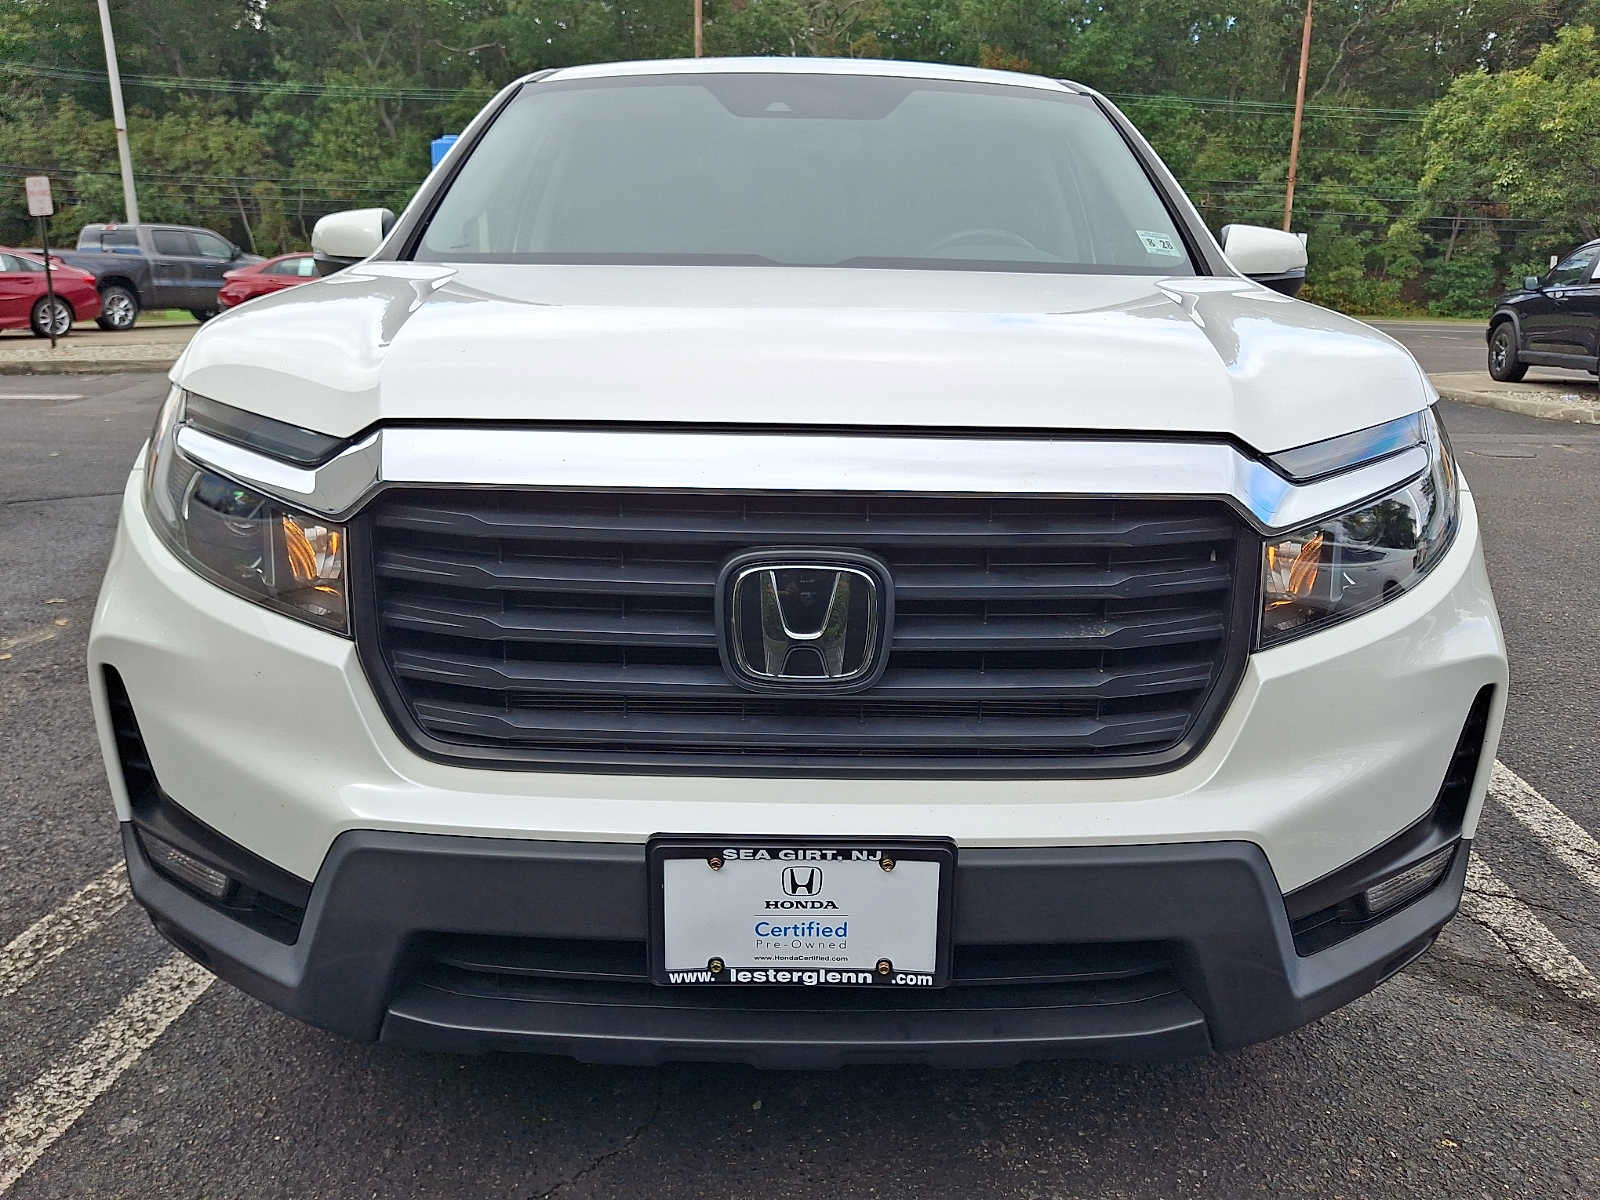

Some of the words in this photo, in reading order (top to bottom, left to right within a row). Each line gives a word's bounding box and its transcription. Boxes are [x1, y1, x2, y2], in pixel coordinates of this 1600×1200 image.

[722, 849, 771, 860] SEA
[778, 850, 843, 861] GIRT,
[851, 850, 882, 861] NJ
[764, 900, 839, 910] HONDA
[755, 921, 848, 937] Certified
[756, 939, 847, 949] Pre-Owned
[669, 971, 716, 984] www.
[730, 969, 873, 985] lesterglenn
[891, 974, 933, 986] .com
